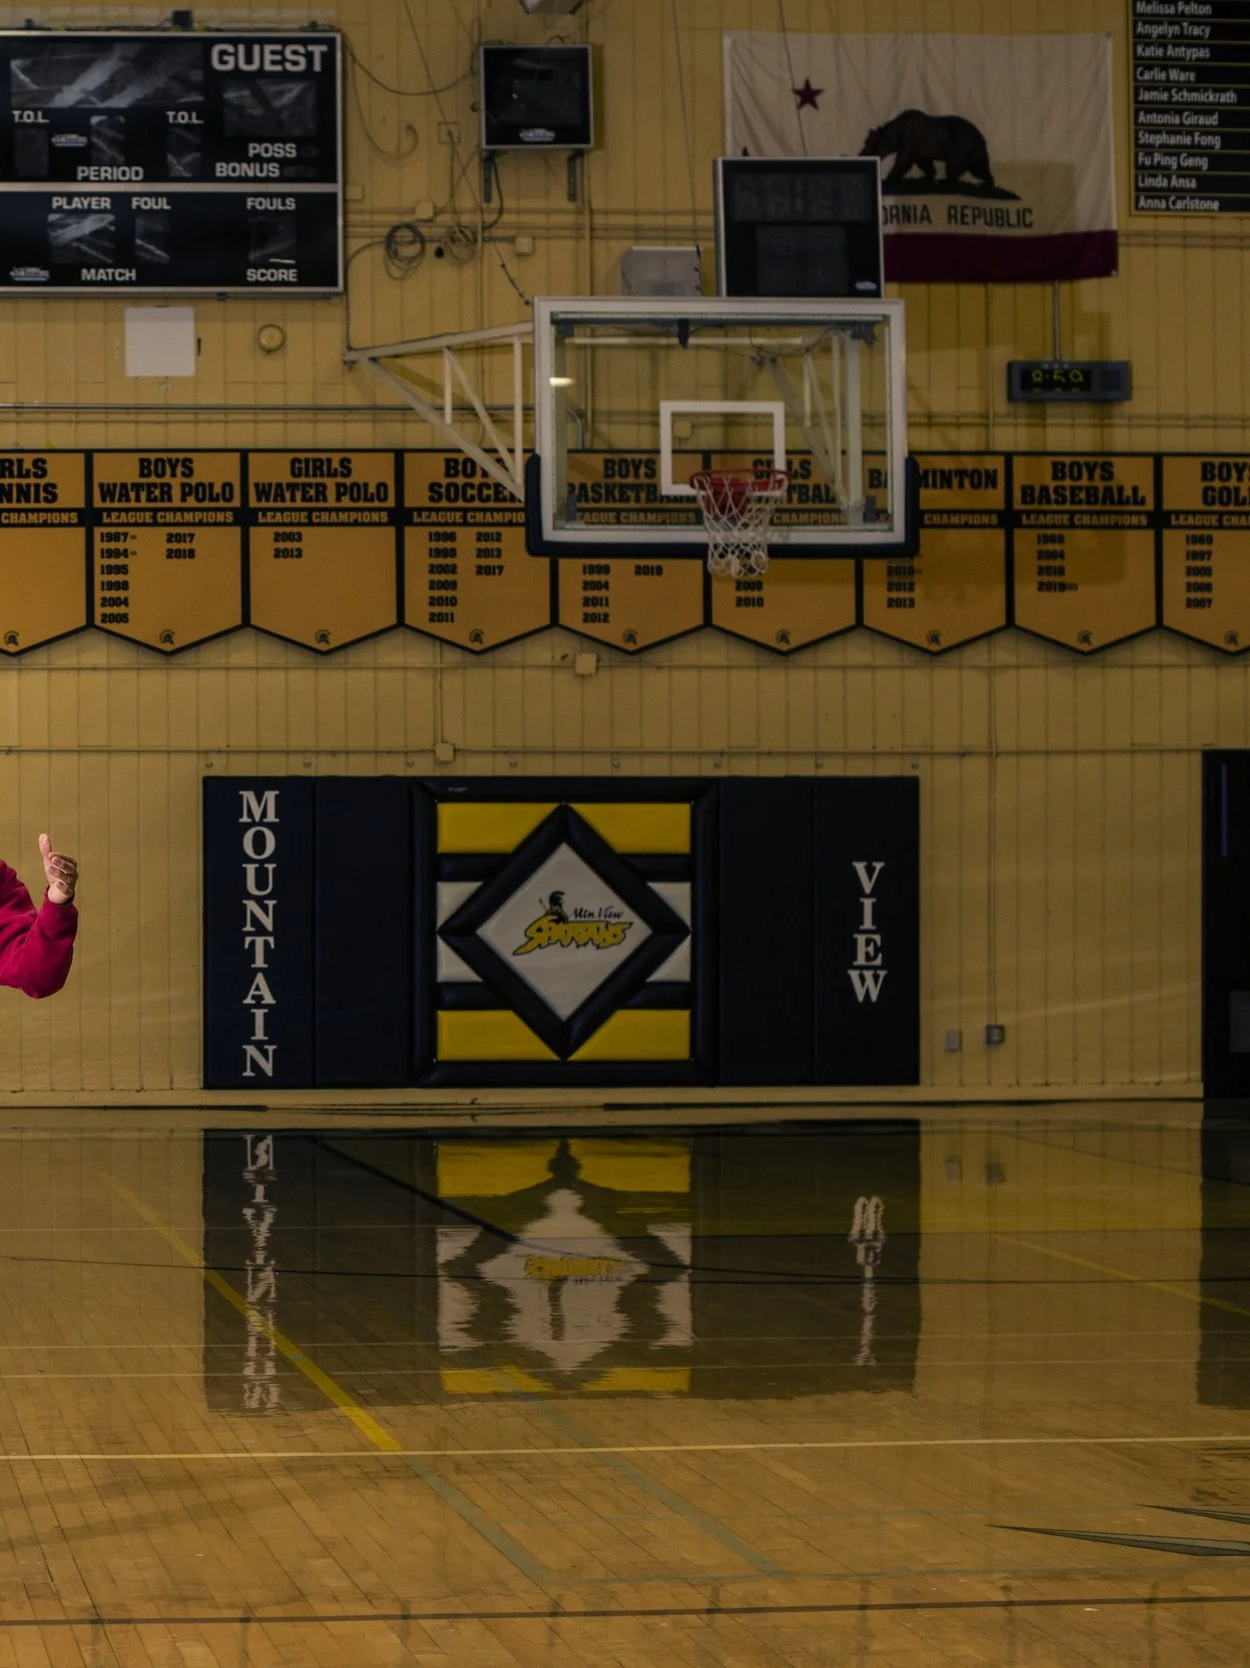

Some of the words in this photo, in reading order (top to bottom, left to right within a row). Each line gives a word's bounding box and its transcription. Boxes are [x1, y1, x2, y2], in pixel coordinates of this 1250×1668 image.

[1136, 1, 1176, 15] Melissa
[1178, 1, 1212, 16] Pelton
[1136, 21, 1181, 38] Angelyn
[1182, 22, 1211, 40] Tracy
[211, 44, 328, 72] GUEST
[1137, 44, 1165, 58] Katie
[1166, 44, 1211, 61] Antypas
[1136, 66, 1167, 81] Carlie
[1169, 67, 1196, 81] Ware
[1138, 87, 1169, 101] Jamie
[12, 110, 49, 123] T.O.L.
[166, 111, 204, 124] T.O.L.
[1138, 110, 1180, 124] Antonia
[1182, 111, 1219, 126] Giraud
[1138, 131, 1192, 148] Stephanie
[1194, 132, 1221, 150] Fong
[248, 143, 297, 158] POSS
[1138, 152, 1151, 166] Fu
[1154, 152, 1178, 170] Ping
[1180, 153, 1209, 170] Geng
[77, 166, 143, 180] PERIOD
[215, 162, 280, 177] BONUS
[1138, 175, 1168, 188] Linda
[52, 196, 111, 209] PLAYER
[131, 197, 171, 209] FOUL
[246, 197, 296, 210] FOULS
[1138, 196, 1166, 209] Anna
[947, 205, 1033, 228] REPUBLIC
[81, 268, 137, 281] MATCH
[246, 268, 298, 281] SCORE
[138, 457, 194, 478] BOYS
[290, 457, 352, 478] GIRLS
[603, 458, 657, 478] BOYS
[1052, 460, 1115, 481] BOYS
[1201, 461, 1250, 482] BOY
[98, 482, 173, 503] WATER
[180, 482, 234, 503] POLO
[254, 482, 328, 503] WATER
[335, 482, 389, 503] POLO
[1021, 484, 1146, 506] BASEBALL
[1202, 486, 1250, 506] GOL
[1, 512, 78, 524] CHAMPIONS
[102, 511, 154, 523] LEAGUE
[157, 511, 234, 523] CHAMPIONS
[258, 511, 309, 523] LEAGUE
[311, 511, 389, 523] CHAMPIONS
[413, 511, 463, 523] LEAGUE
[467, 511, 525, 523] CHAMPIO
[924, 513, 998, 525] CHAMPIONS
[1022, 514, 1070, 526] LEAGUE
[1074, 514, 1149, 526] CHAMPIONS
[1172, 514, 1220, 526] LEAGUE
[598, 905, 624, 919] View
[238, 790, 280, 1077] MOUNTAIN
[847, 861, 888, 1003] VIEW
